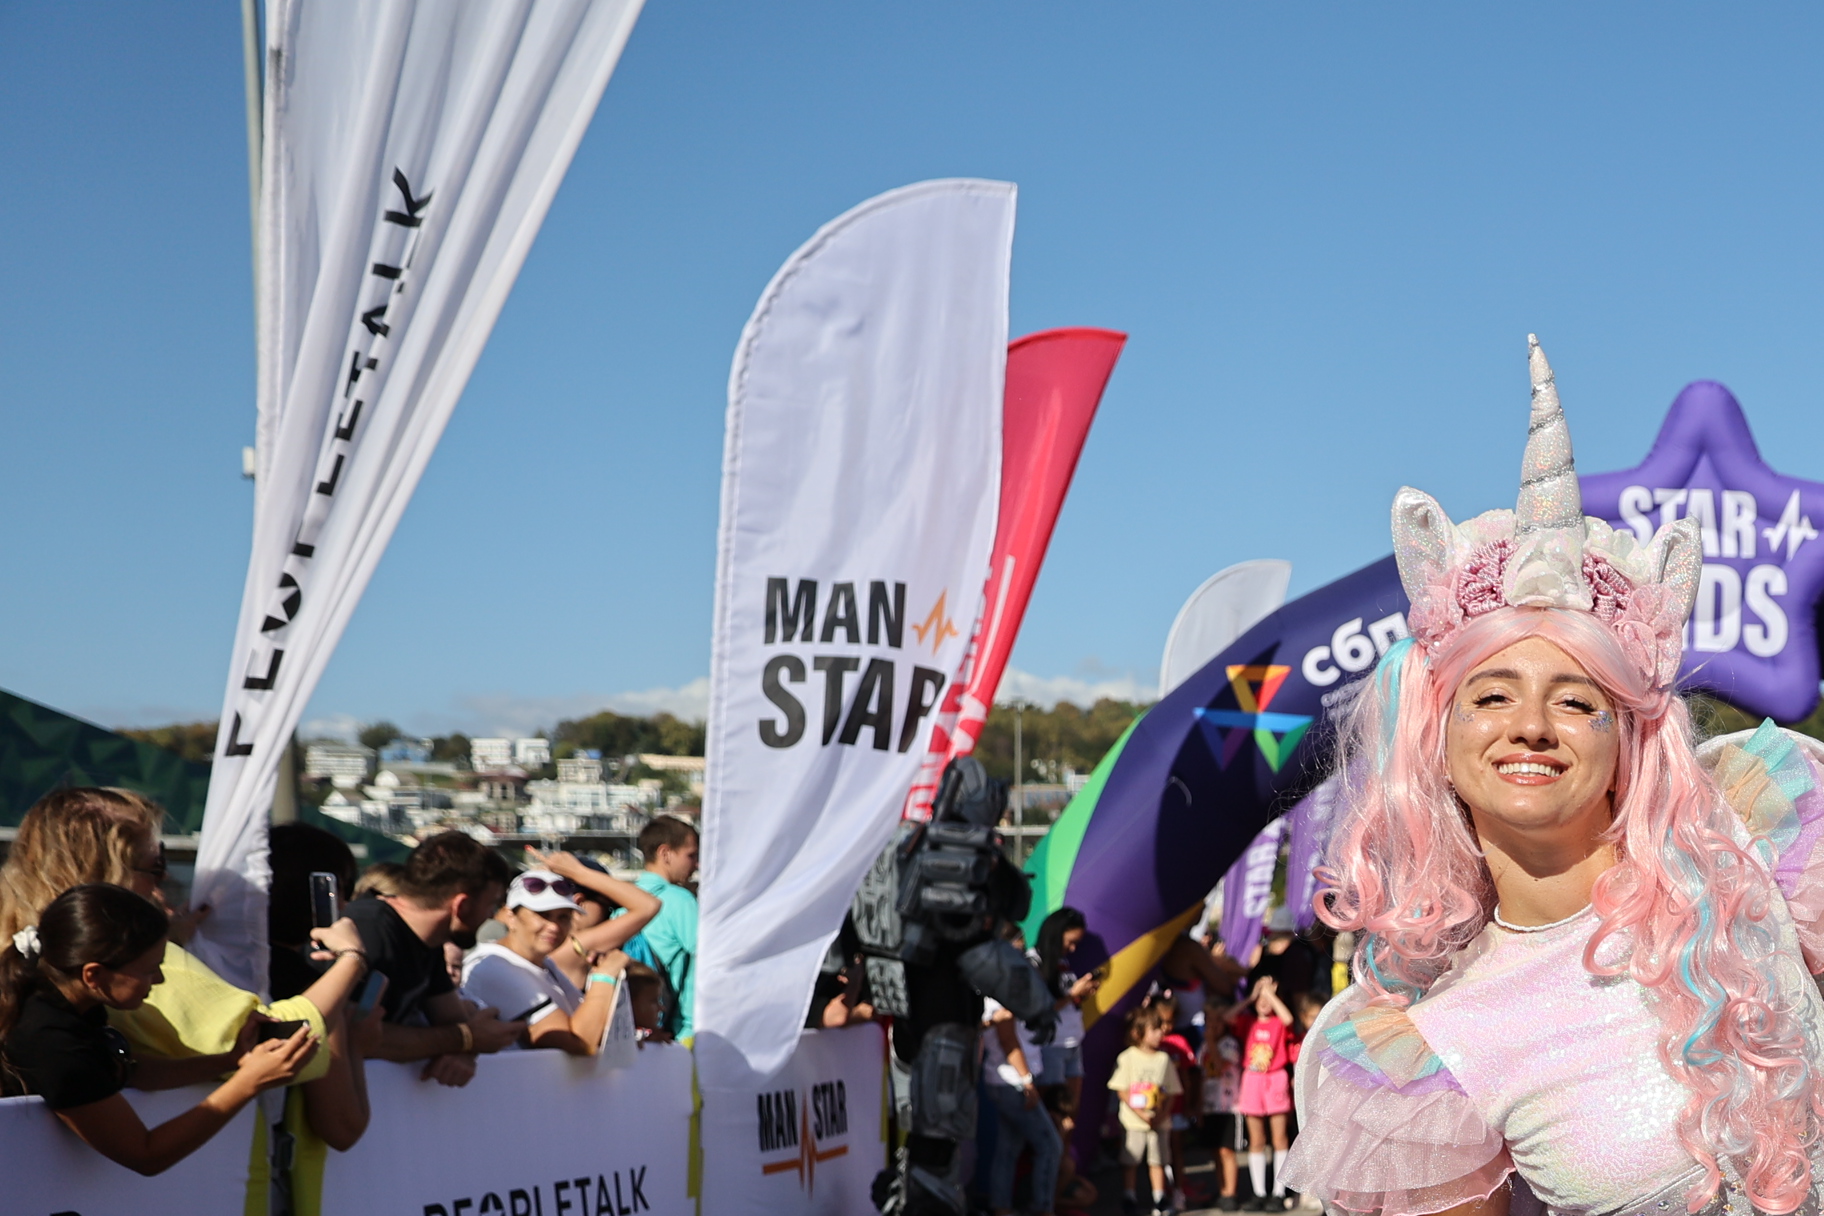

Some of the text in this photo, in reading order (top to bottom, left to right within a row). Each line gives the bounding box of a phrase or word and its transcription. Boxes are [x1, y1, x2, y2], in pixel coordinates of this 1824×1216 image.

[1617, 484, 1758, 559] STAR
[763, 576, 907, 650] MAN
[1682, 562, 1790, 658] DS
[757, 1078, 849, 1153] MAN STAR
